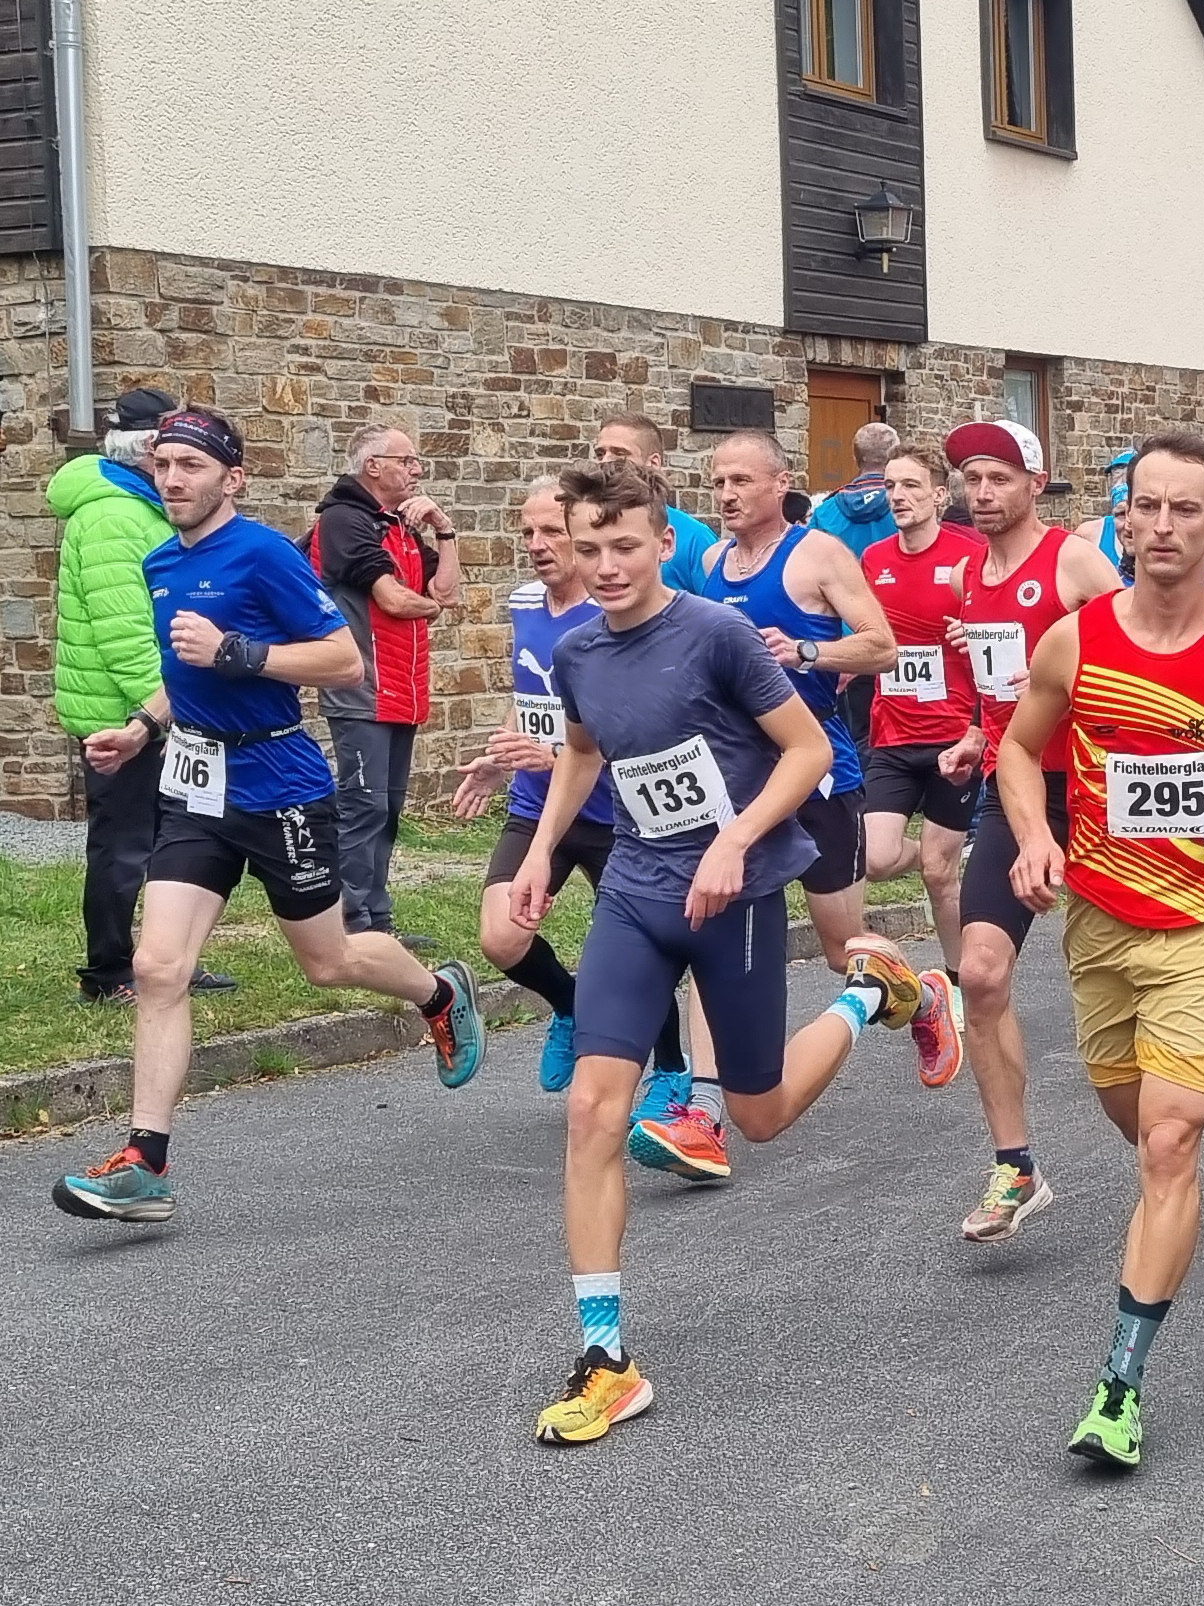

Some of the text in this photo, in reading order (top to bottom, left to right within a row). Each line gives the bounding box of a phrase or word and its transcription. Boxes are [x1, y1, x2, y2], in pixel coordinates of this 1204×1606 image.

[893, 661, 932, 682] 104
[982, 645, 993, 676] 1
[520, 710, 554, 735] 190
[172, 750, 209, 788] 106
[617, 744, 702, 780] Fichtelberglauf
[636, 771, 706, 816] 133
[282, 821, 298, 865] RUNNERS
